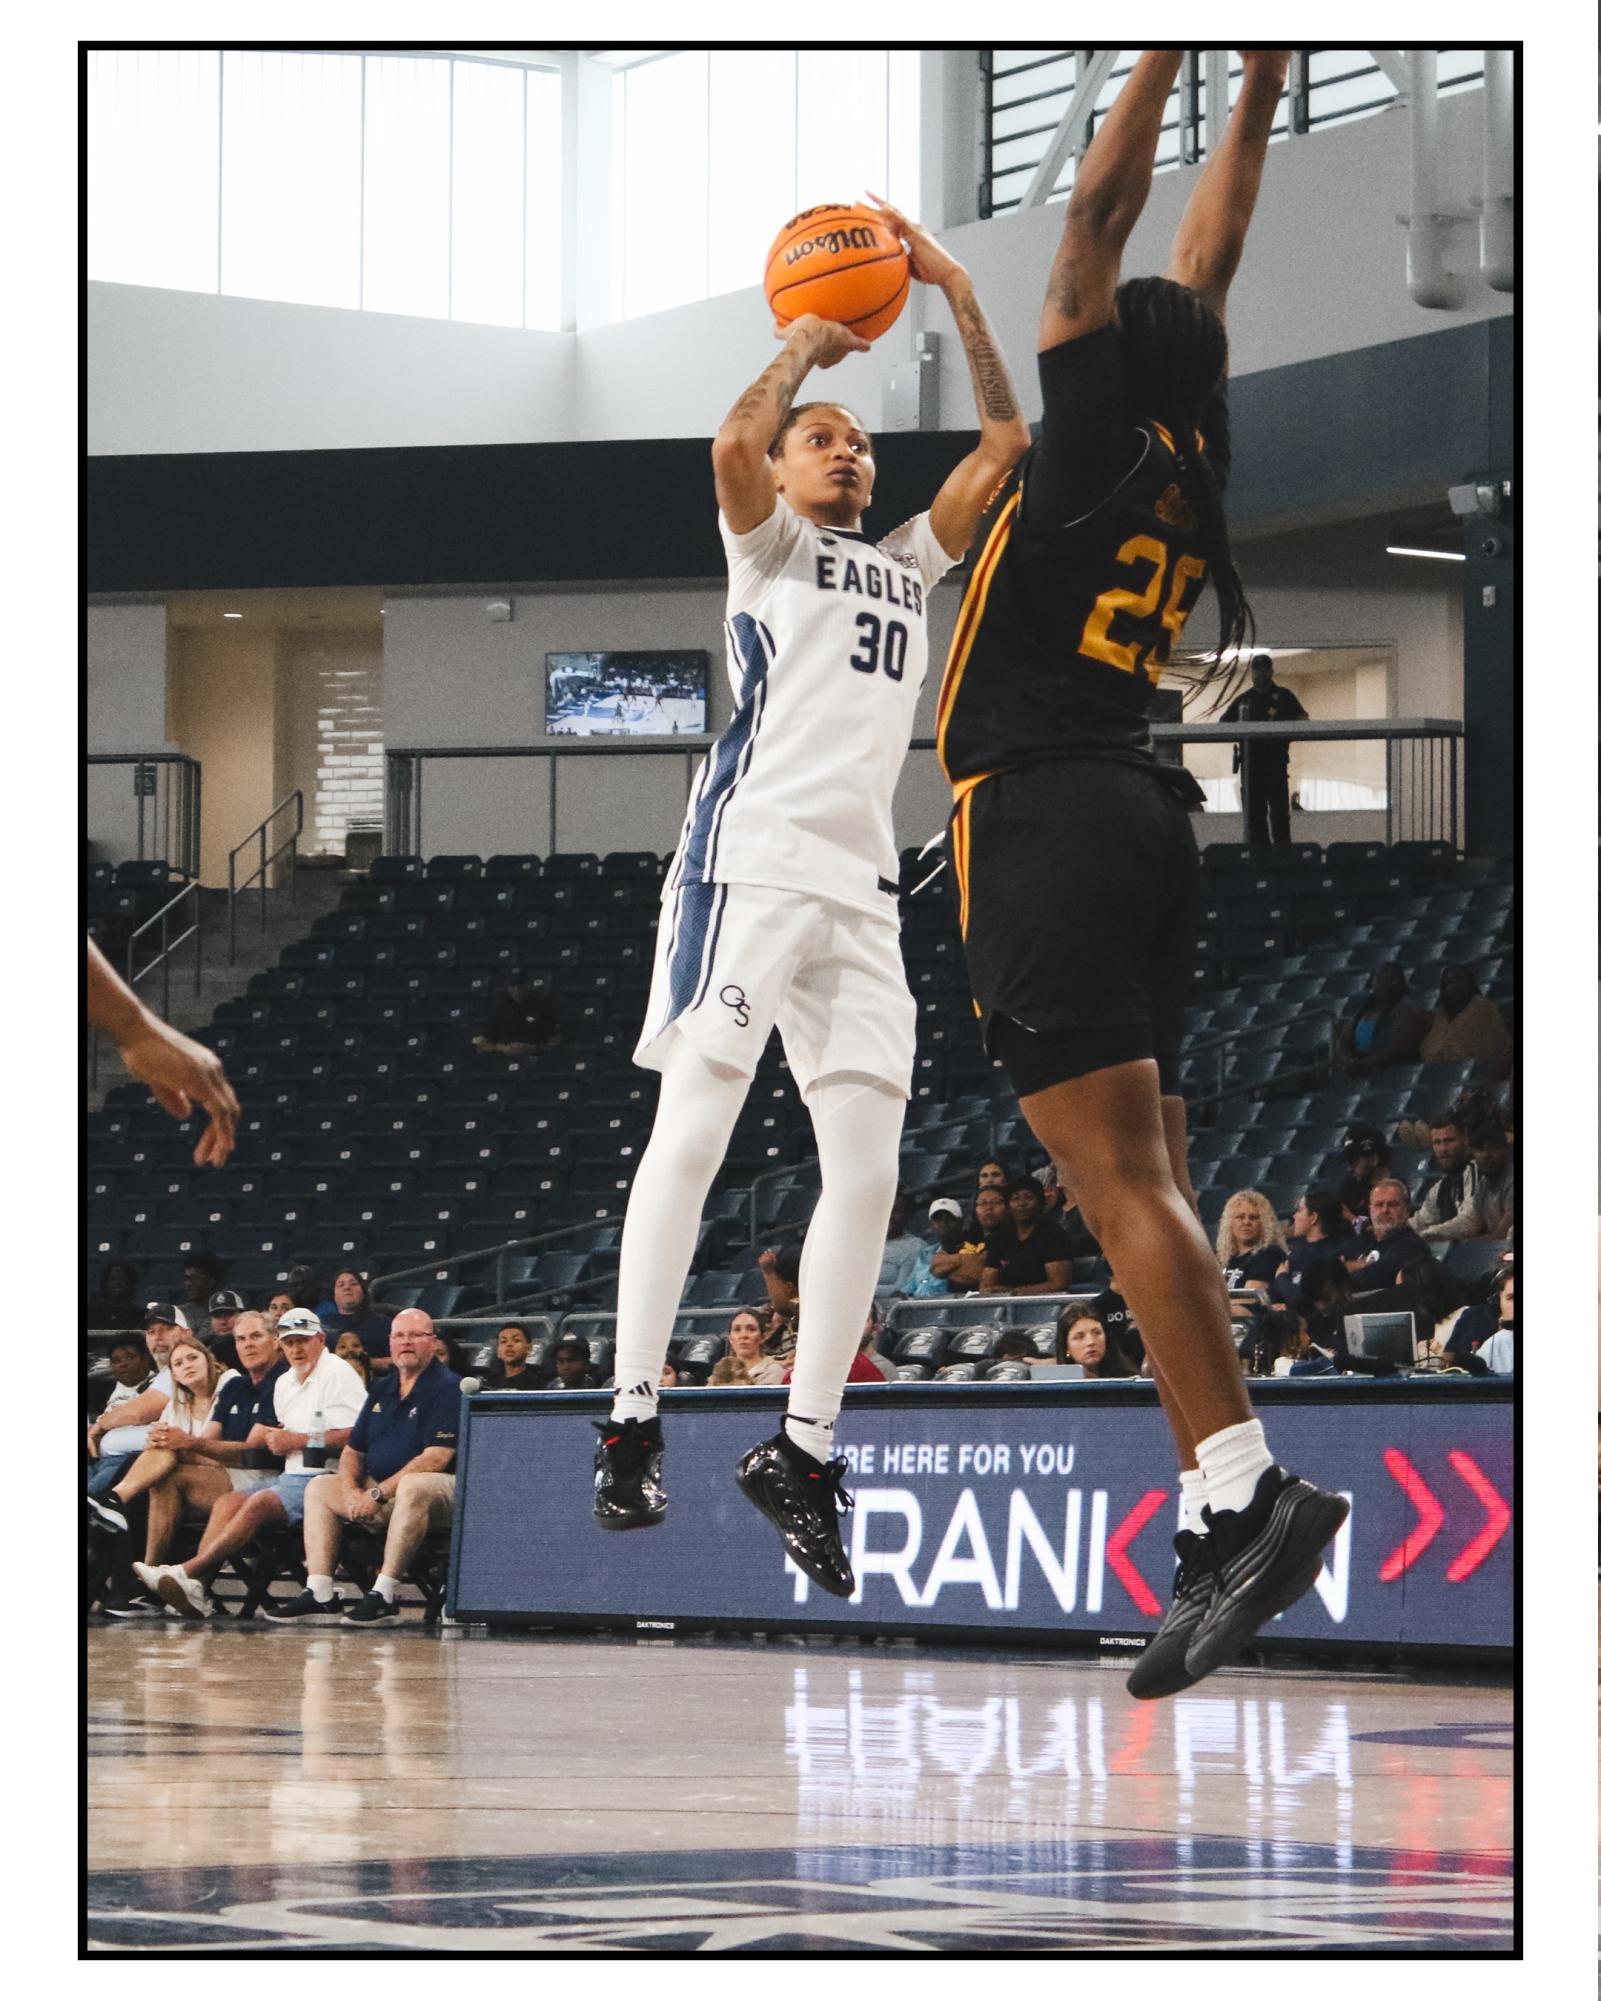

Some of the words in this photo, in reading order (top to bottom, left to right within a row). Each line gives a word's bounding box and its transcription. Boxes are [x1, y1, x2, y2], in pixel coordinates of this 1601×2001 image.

[785, 226, 879, 265] Wilson
[816, 555, 922, 616] EAGLES
[850, 612, 908, 682] 30
[883, 1444, 949, 1474] HERE
[958, 1444, 1010, 1475] FOR
[1018, 1444, 1075, 1475] YOU
[1099, 1637, 1147, 1646] DAKTRONICS
